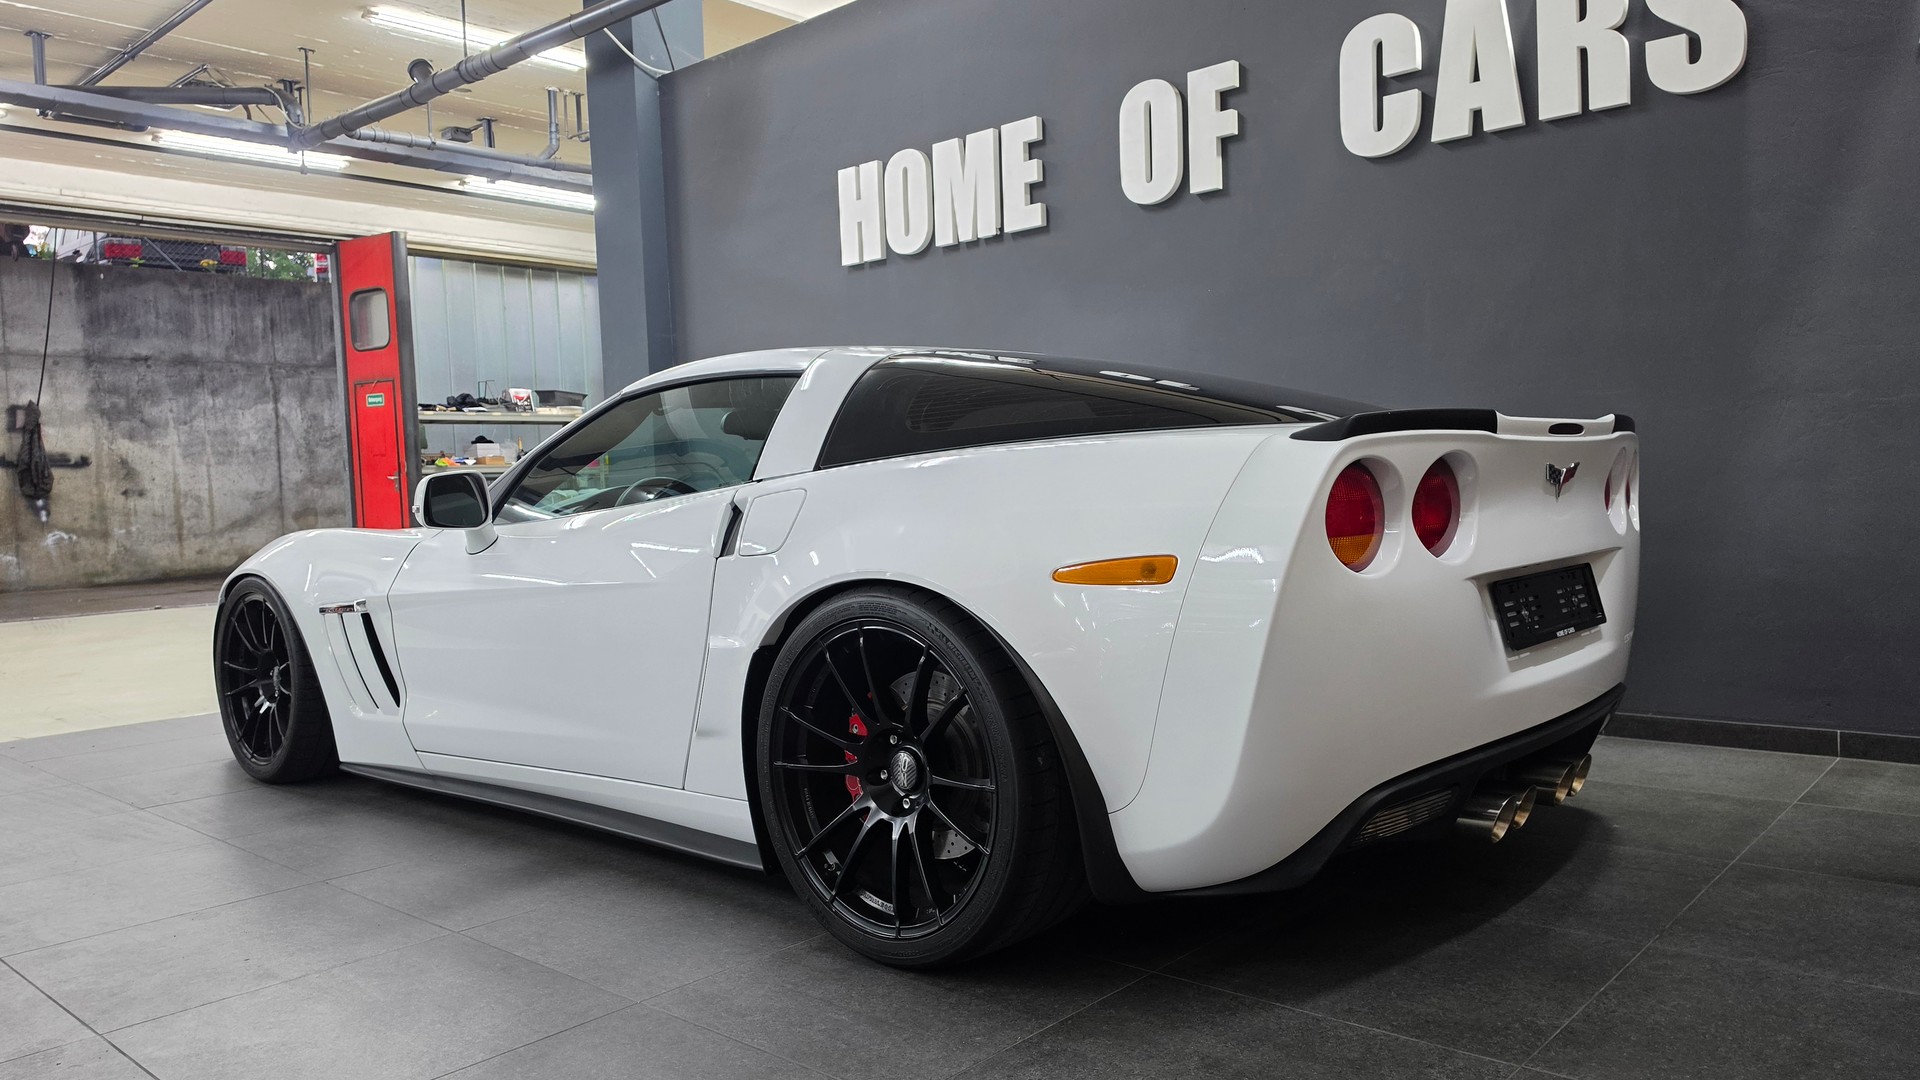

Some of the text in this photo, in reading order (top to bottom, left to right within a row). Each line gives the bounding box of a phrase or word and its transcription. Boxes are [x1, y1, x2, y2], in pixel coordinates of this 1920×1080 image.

[838, 0, 1748, 267] HOME OF CARS
